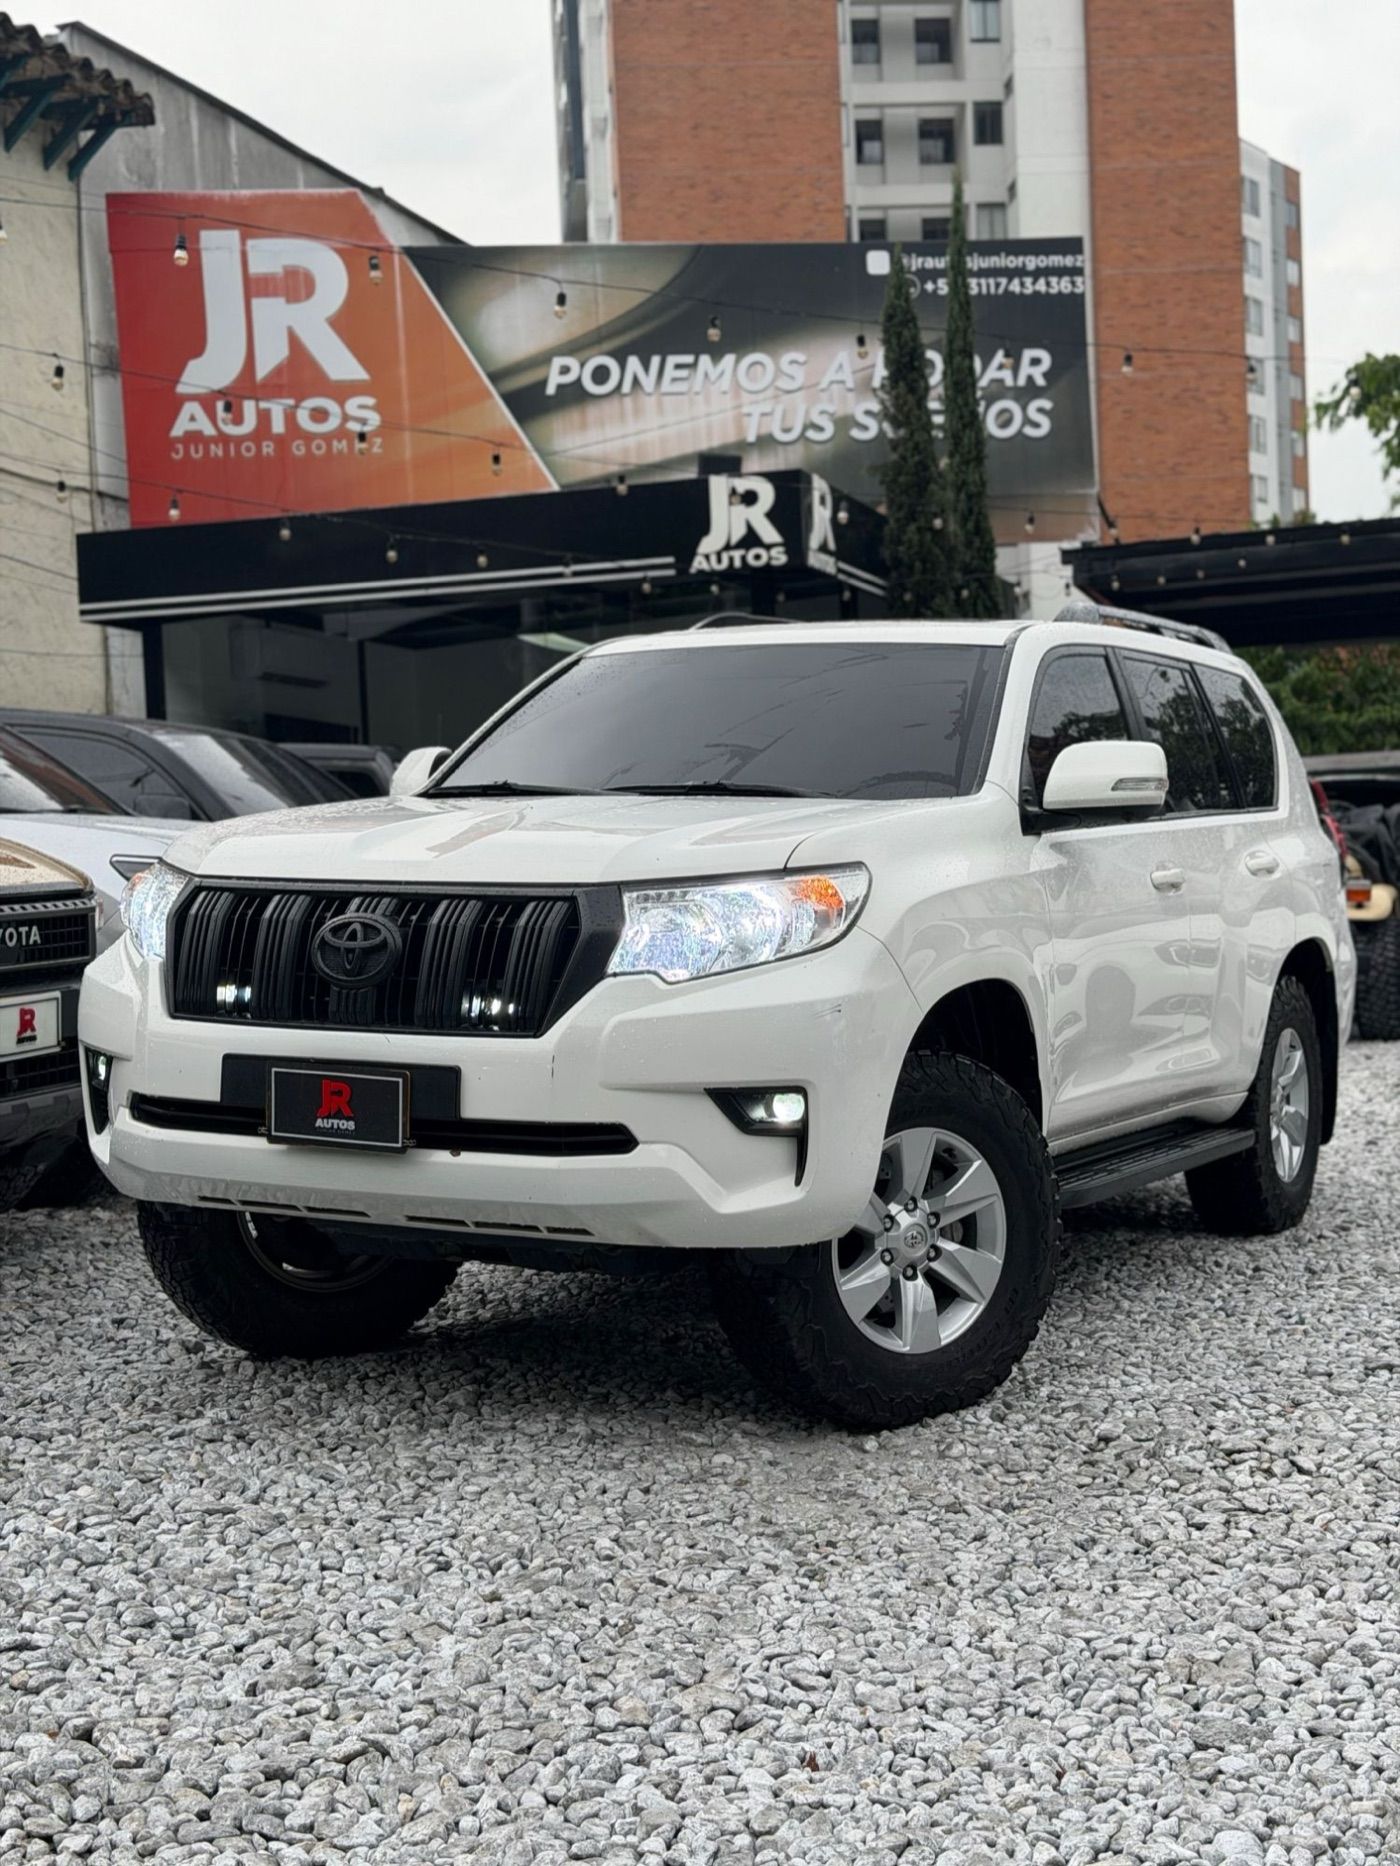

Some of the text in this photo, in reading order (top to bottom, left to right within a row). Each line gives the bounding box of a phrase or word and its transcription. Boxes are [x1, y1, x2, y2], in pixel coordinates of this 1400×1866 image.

[969, 276, 1085, 295] 3117434363
[175, 229, 371, 394] JR
[545, 352, 806, 396] PONEMOS
[818, 348, 854, 393] A
[169, 396, 382, 438] AUTOS
[743, 402, 835, 443] TUS
[171, 441, 275, 459] JUNIOR
[696, 474, 784, 553] JR
[689, 546, 789, 574] AUTOS
[317, 1079, 354, 1117] JR
[315, 1117, 356, 1131] AUTOS
